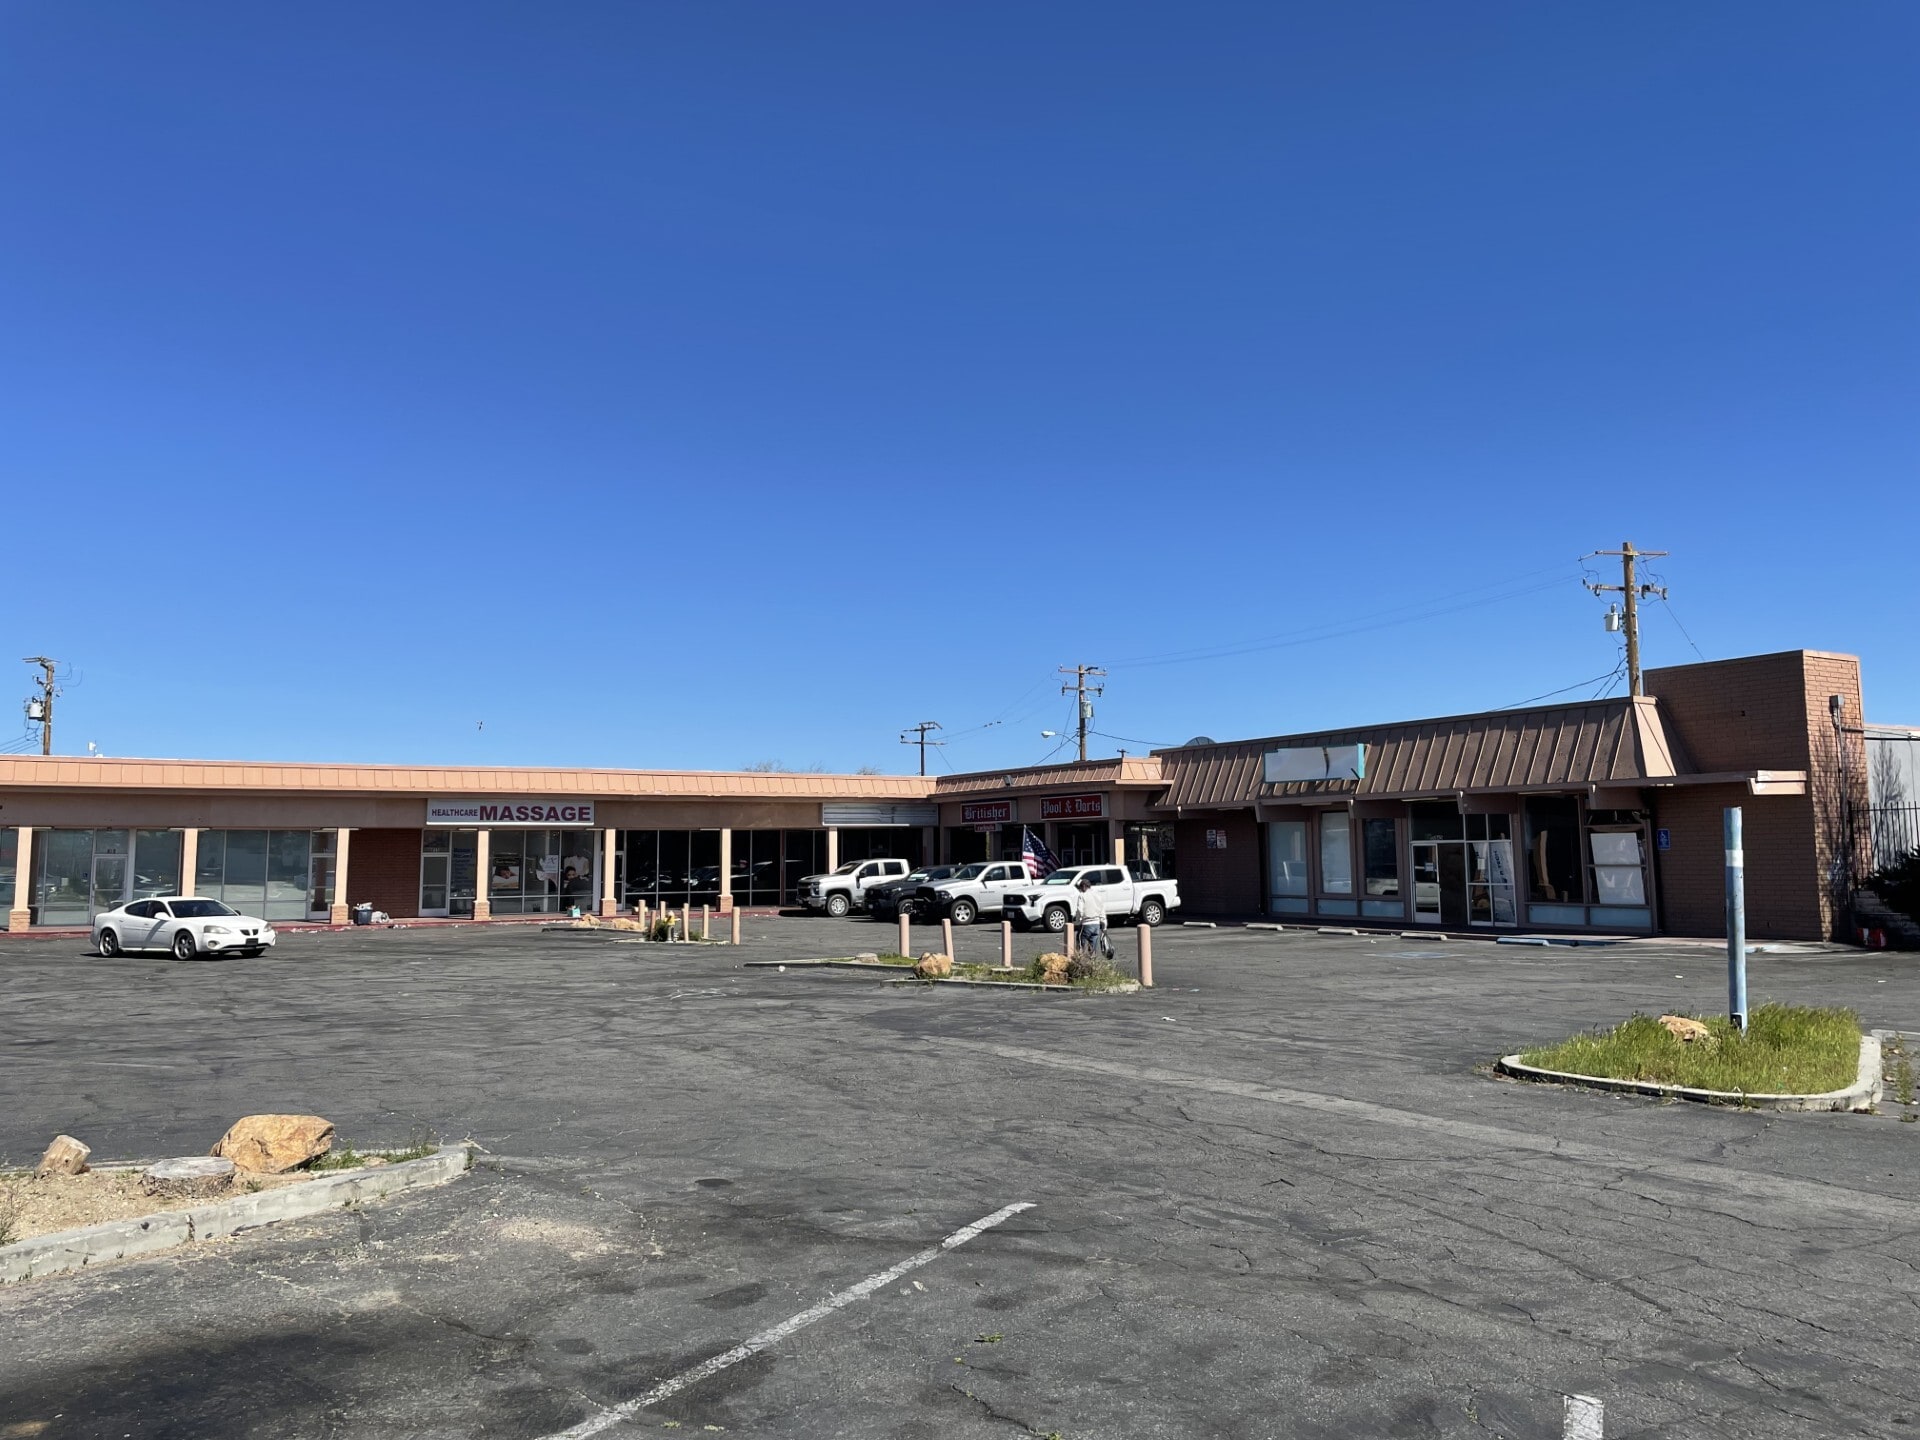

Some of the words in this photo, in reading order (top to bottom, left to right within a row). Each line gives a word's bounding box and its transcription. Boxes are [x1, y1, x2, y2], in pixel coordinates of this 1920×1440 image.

[431, 808, 478, 817] HEALTHCARE
[479, 805, 591, 821] MASSAGE
[964, 805, 1007, 820] Britisher
[1042, 800, 1061, 816] Pool
[1065, 800, 1072, 813] &
[1075, 799, 1100, 812] Darts
